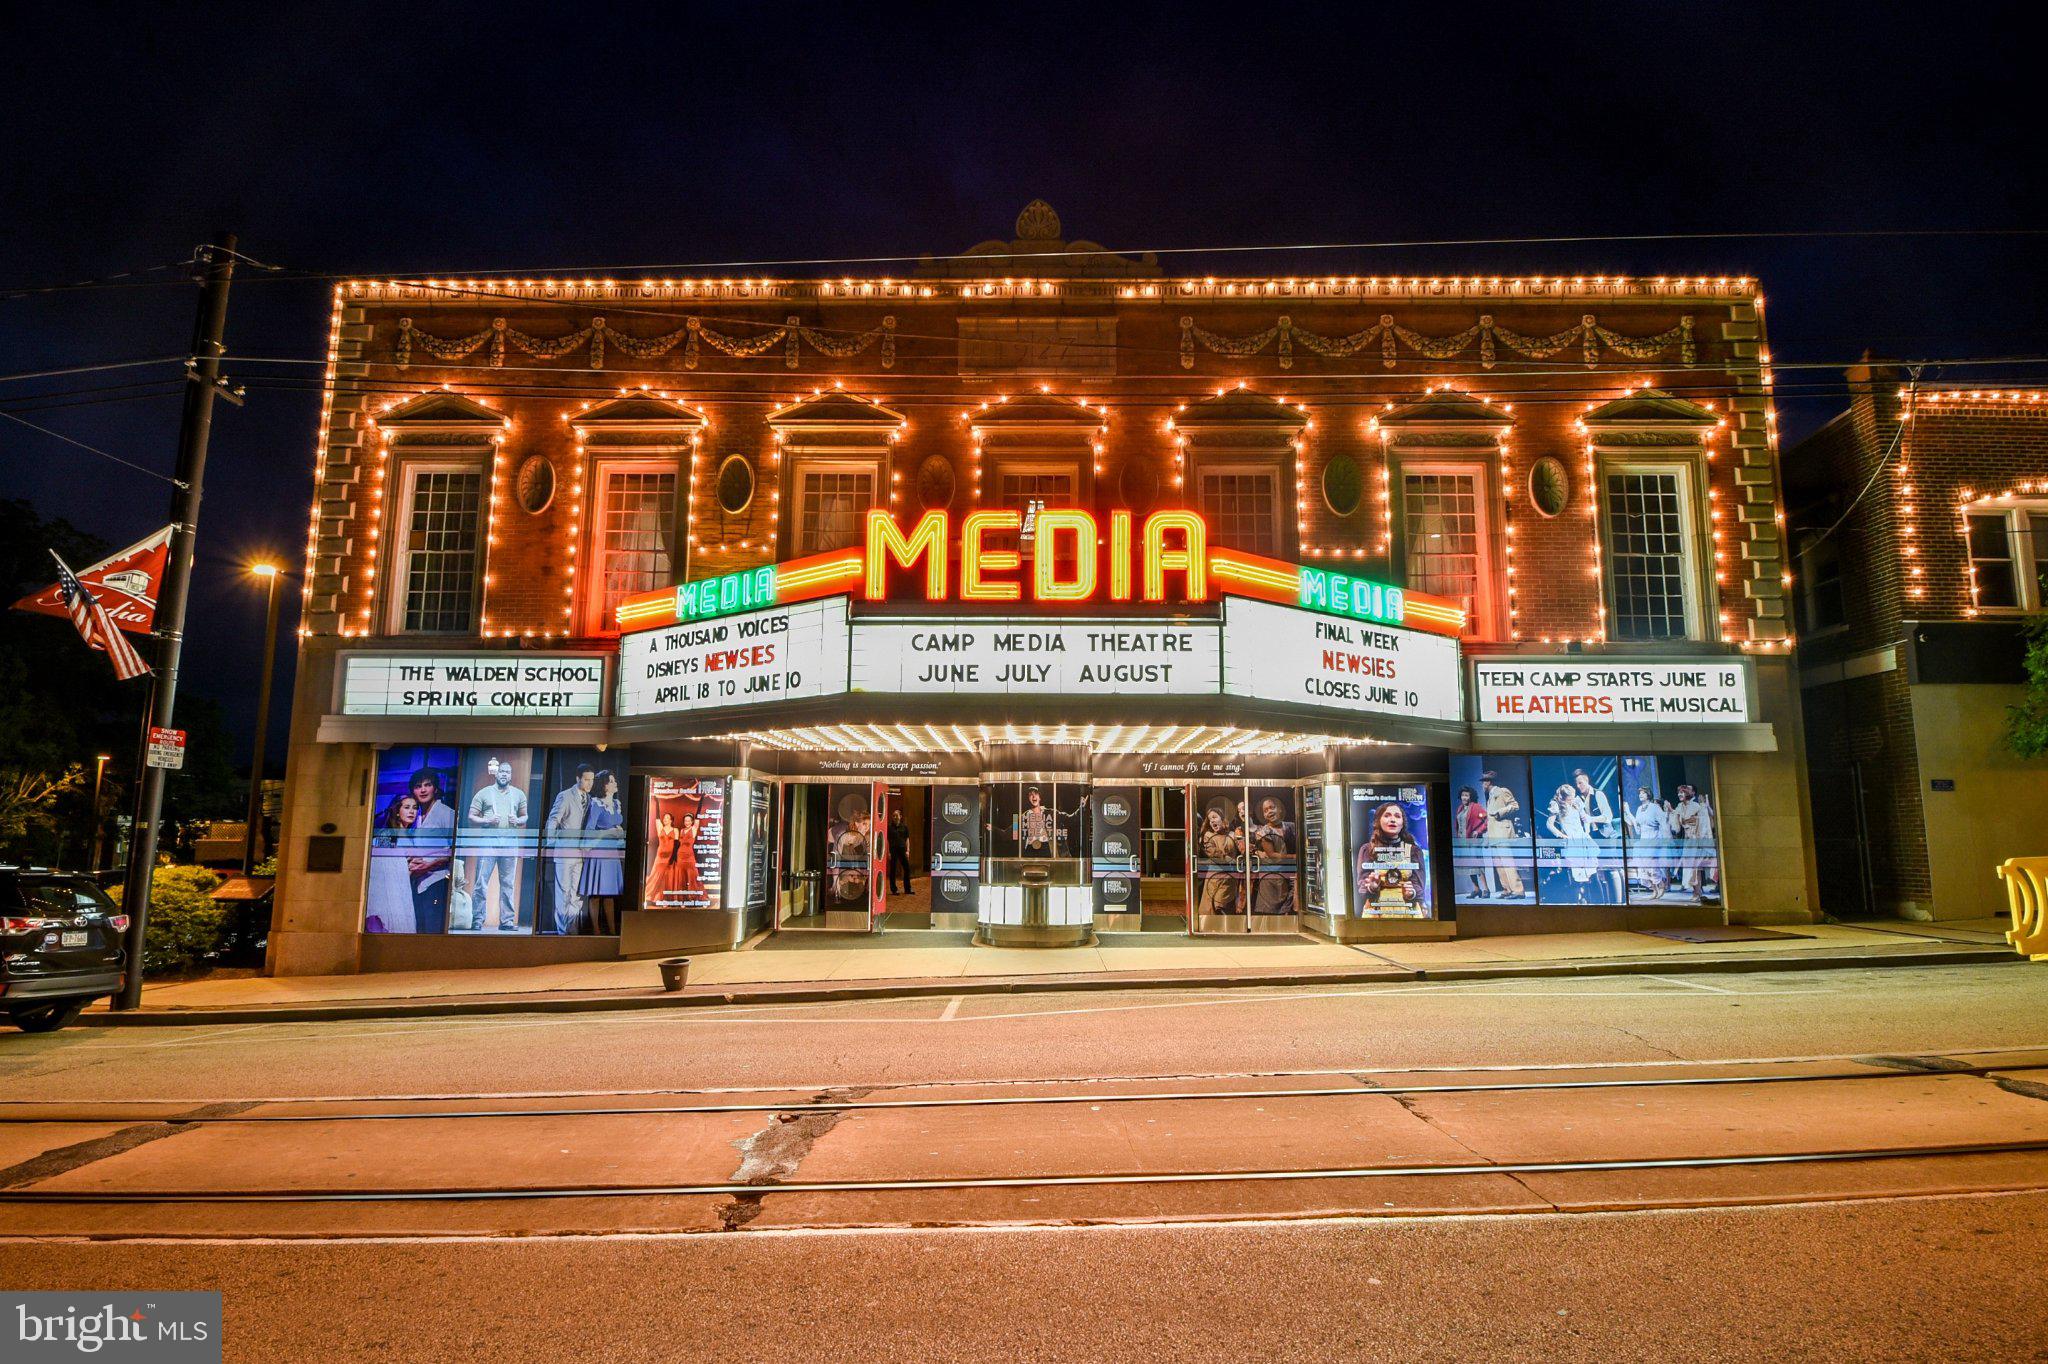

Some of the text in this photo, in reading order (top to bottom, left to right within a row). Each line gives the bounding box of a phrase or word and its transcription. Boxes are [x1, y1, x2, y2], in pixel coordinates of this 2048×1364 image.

[866, 509, 1207, 600] MEDIA
[675, 567, 775, 618] MEDIA
[1301, 569, 1405, 622] MEDIA
[649, 615, 789, 654] A THOUSAND VOICES
[911, 633, 1193, 652] CAMP MEDIA THEATRE
[1315, 621, 1400, 652] FINAL WEEK
[647, 644, 775, 679] DISNEYS NEWSIES
[1322, 649, 1396, 679] NEWSIES
[400, 666, 598, 682] THE WALDEN SCHOOL
[918, 664, 1173, 683] JUNE JULY AUGUST
[1479, 671, 1736, 687] TEEN CAMP STARTS JUNE 18
[655, 671, 801, 704] APRIL 18 TO JUNE 10
[1305, 677, 1418, 707] CLOSES JUNE 10
[403, 691, 574, 707] SPRING CONCERT
[1496, 695, 1743, 714] HEATHERS THE MUSICAL
[852, 761, 859, 769] is
[887, 762, 909, 771] except
[1160, 763, 1184, 771] cannot
[1185, 762, 1199, 773] fly,
[1201, 762, 1211, 771] let
[1022, 813, 1053, 822] MEDIA
[1022, 821, 1053, 829] MUSIC
[1022, 829, 1068, 837] THEATRE
